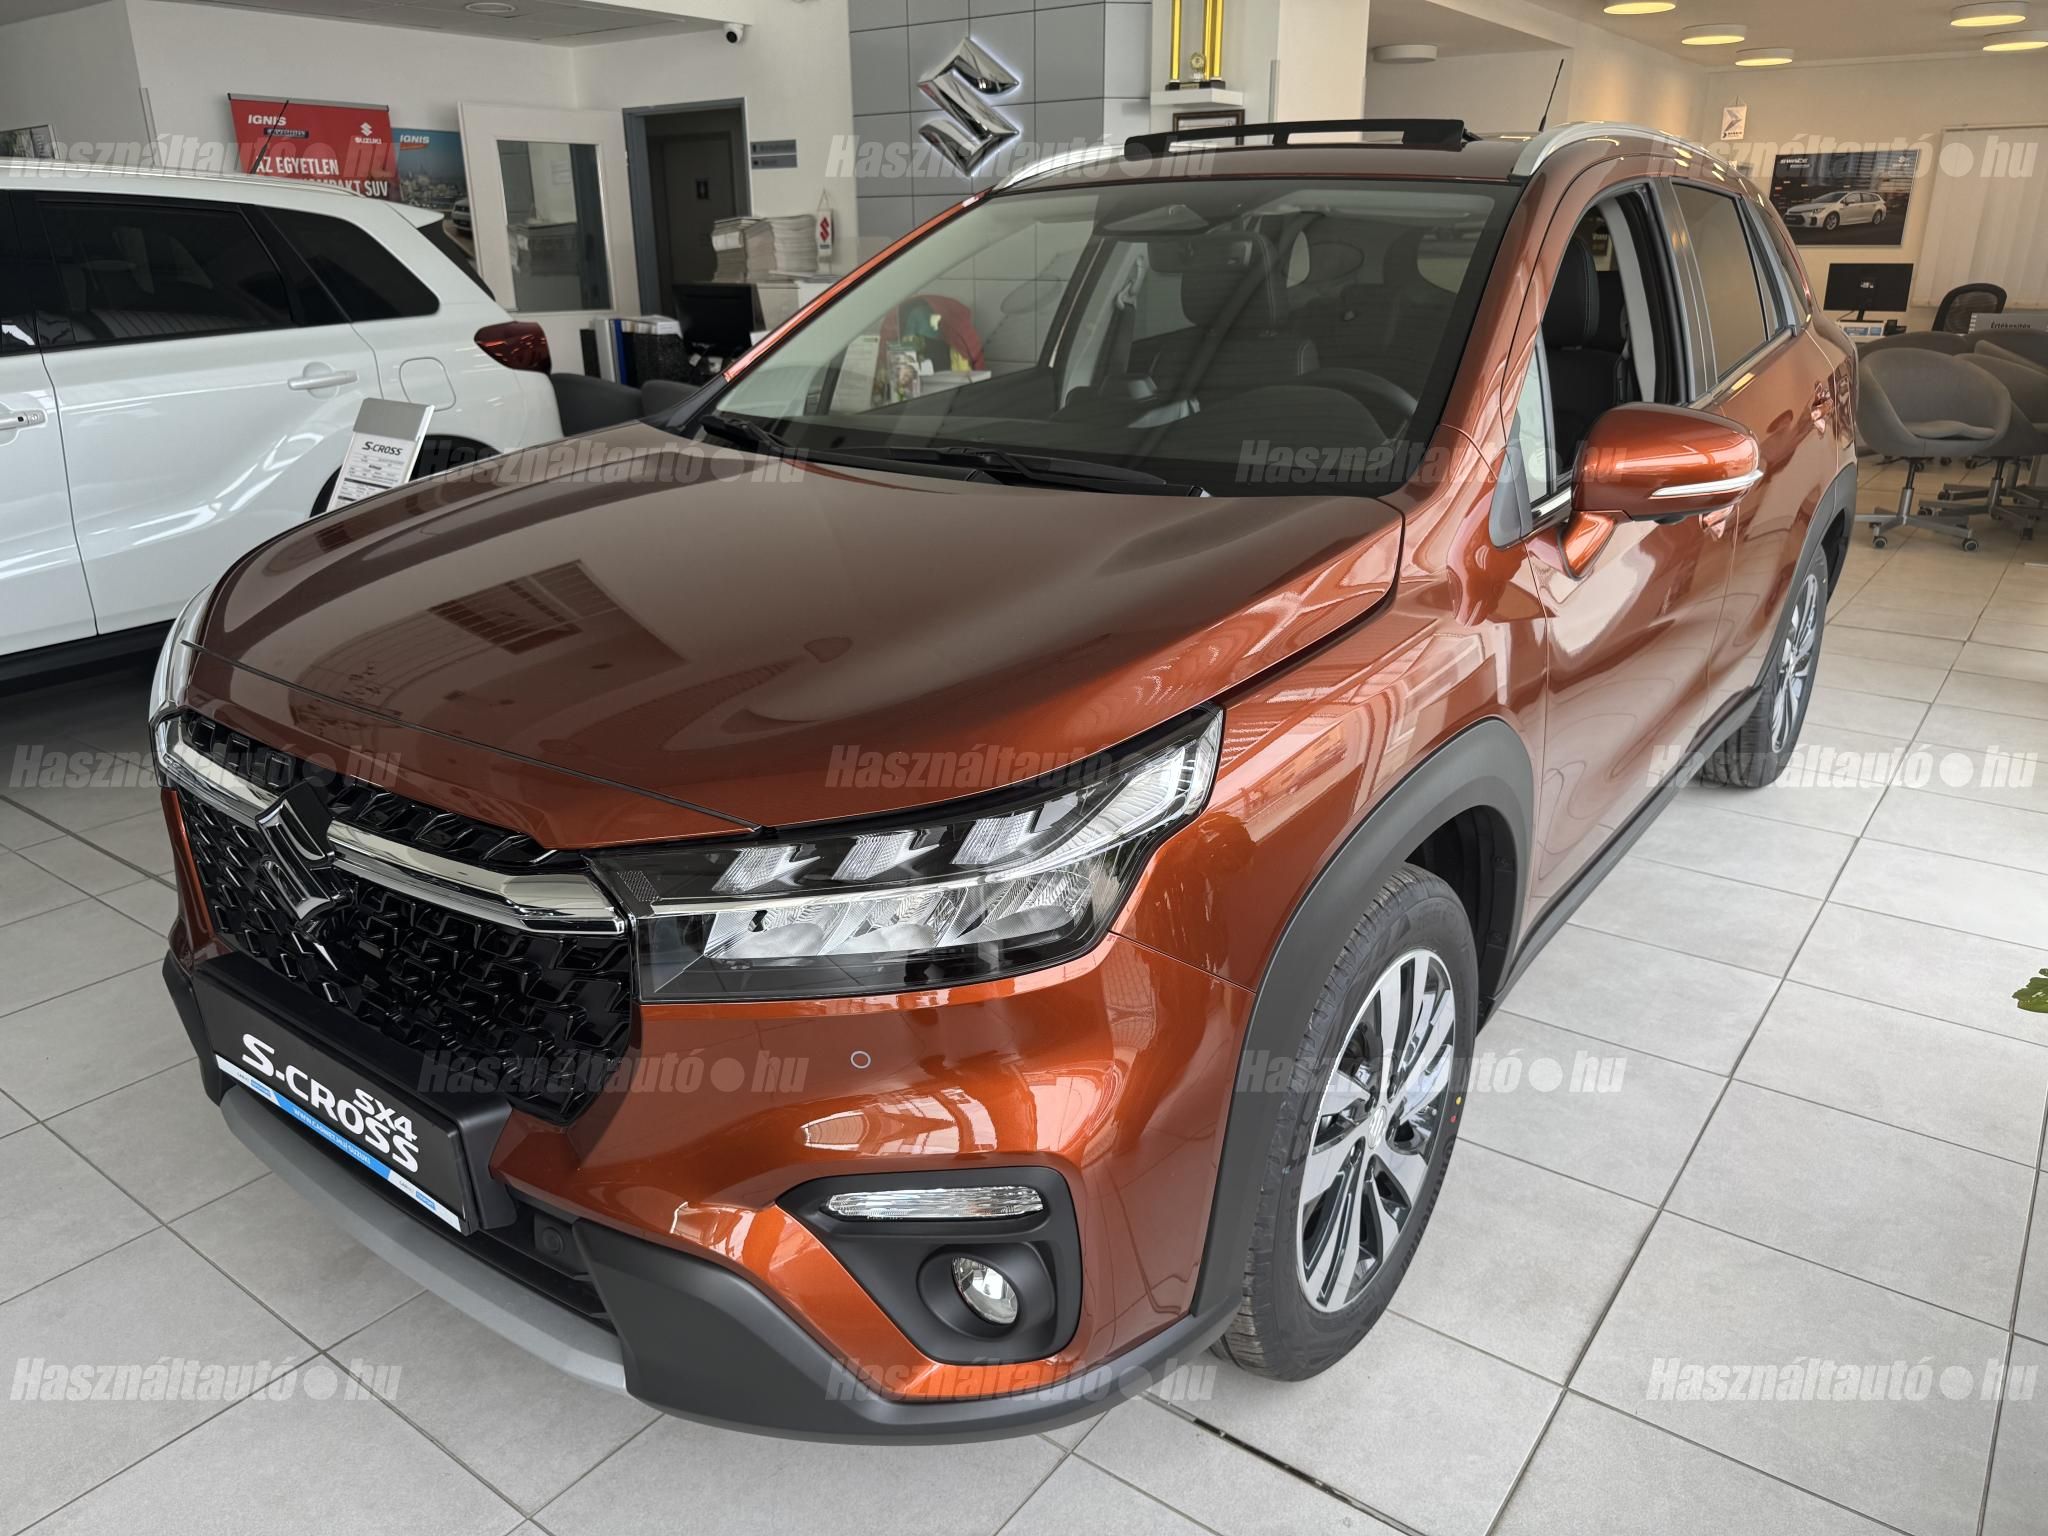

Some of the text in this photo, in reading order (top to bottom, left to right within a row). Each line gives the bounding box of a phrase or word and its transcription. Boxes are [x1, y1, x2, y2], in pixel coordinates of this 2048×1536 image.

[248, 114, 287, 126] IGNIS
[399, 134, 430, 145] IGNIS
[255, 156, 340, 176] AZ EGYETLEN
[364, 180, 389, 198] SUV
[242, 1033, 419, 1173] S-CROSS
[353, 1088, 418, 1142] SX4
